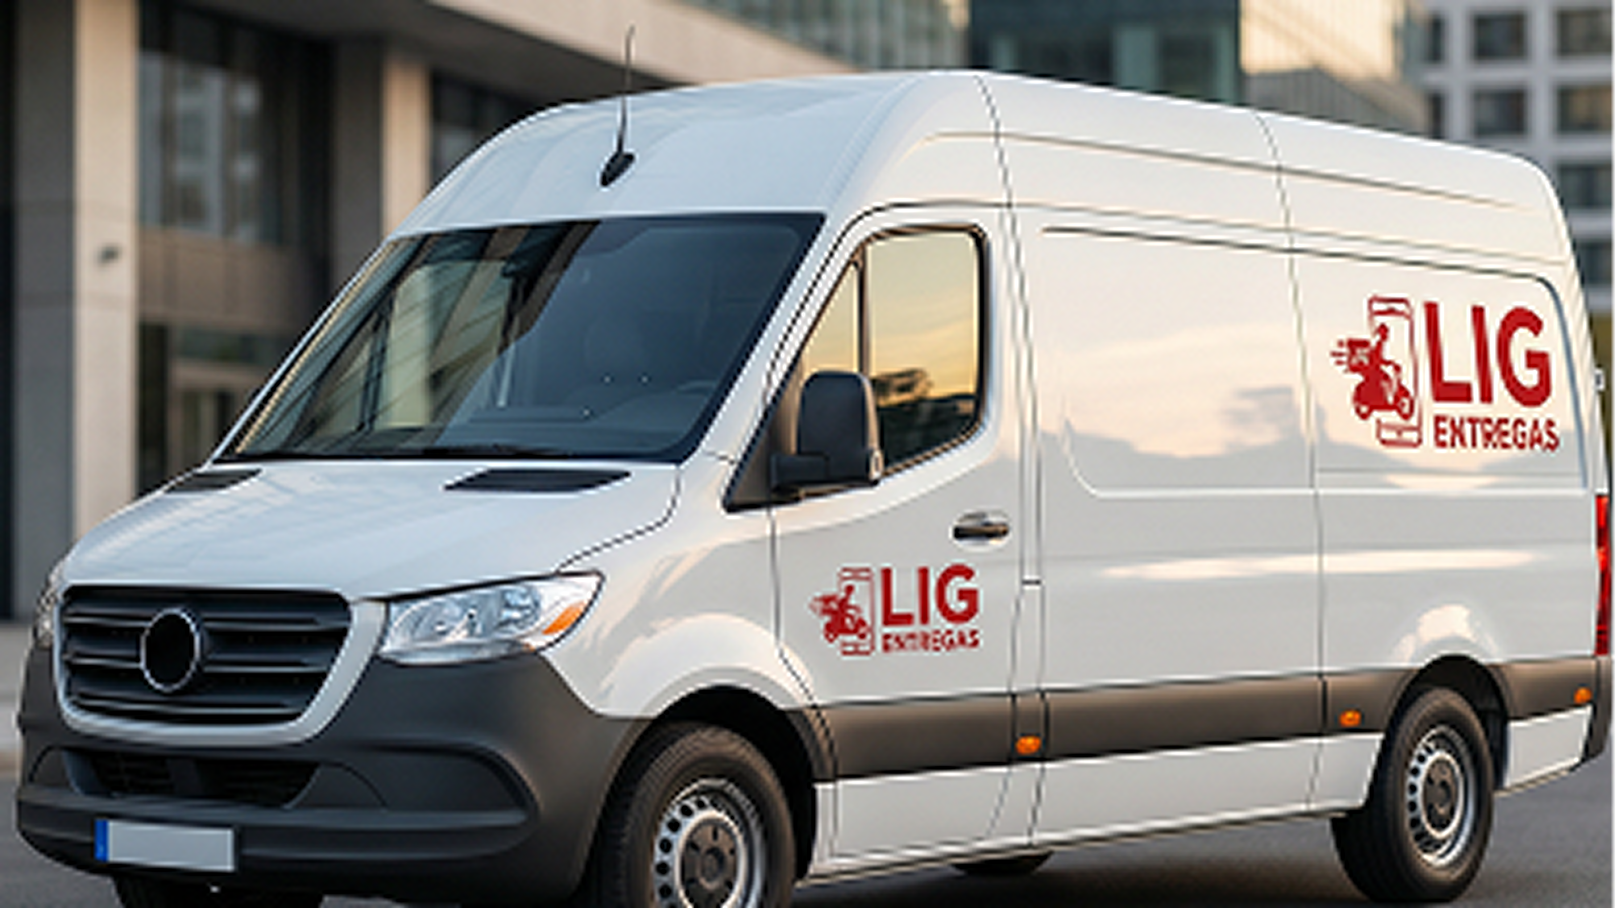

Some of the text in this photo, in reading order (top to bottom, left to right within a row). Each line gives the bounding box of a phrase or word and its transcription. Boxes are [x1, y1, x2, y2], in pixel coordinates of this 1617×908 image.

[1423, 301, 1552, 407] LIG
[1433, 414, 1560, 452] ENTREGAS
[880, 563, 979, 627] LIG
[882, 629, 980, 653] ENTREGAS
